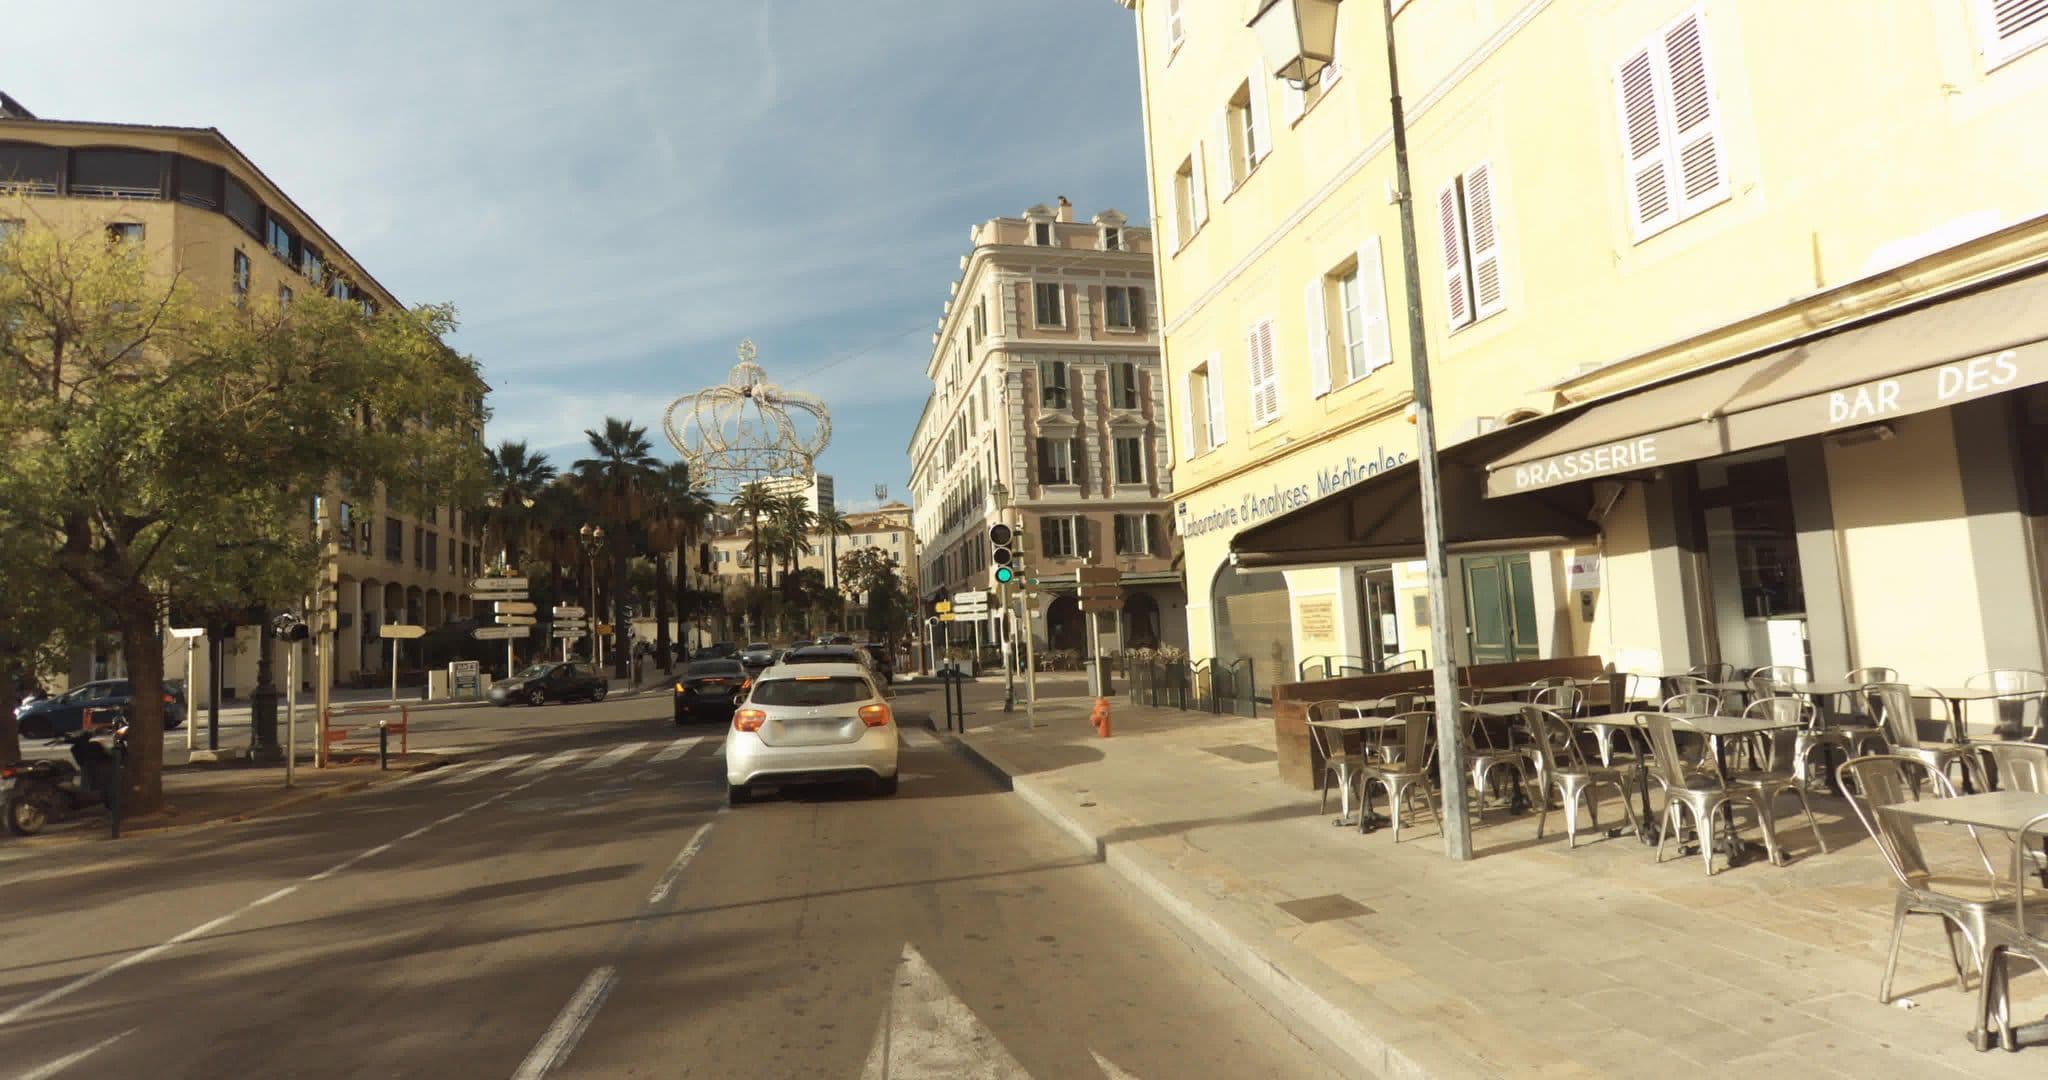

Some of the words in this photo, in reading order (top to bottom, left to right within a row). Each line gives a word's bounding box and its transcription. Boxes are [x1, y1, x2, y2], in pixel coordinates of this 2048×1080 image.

[1515, 438, 1656, 488] BRASSERIE
[1829, 379, 1900, 424] BAR
[1937, 350, 2017, 401] DES
[1183, 504, 1238, 538] Laboratoire
